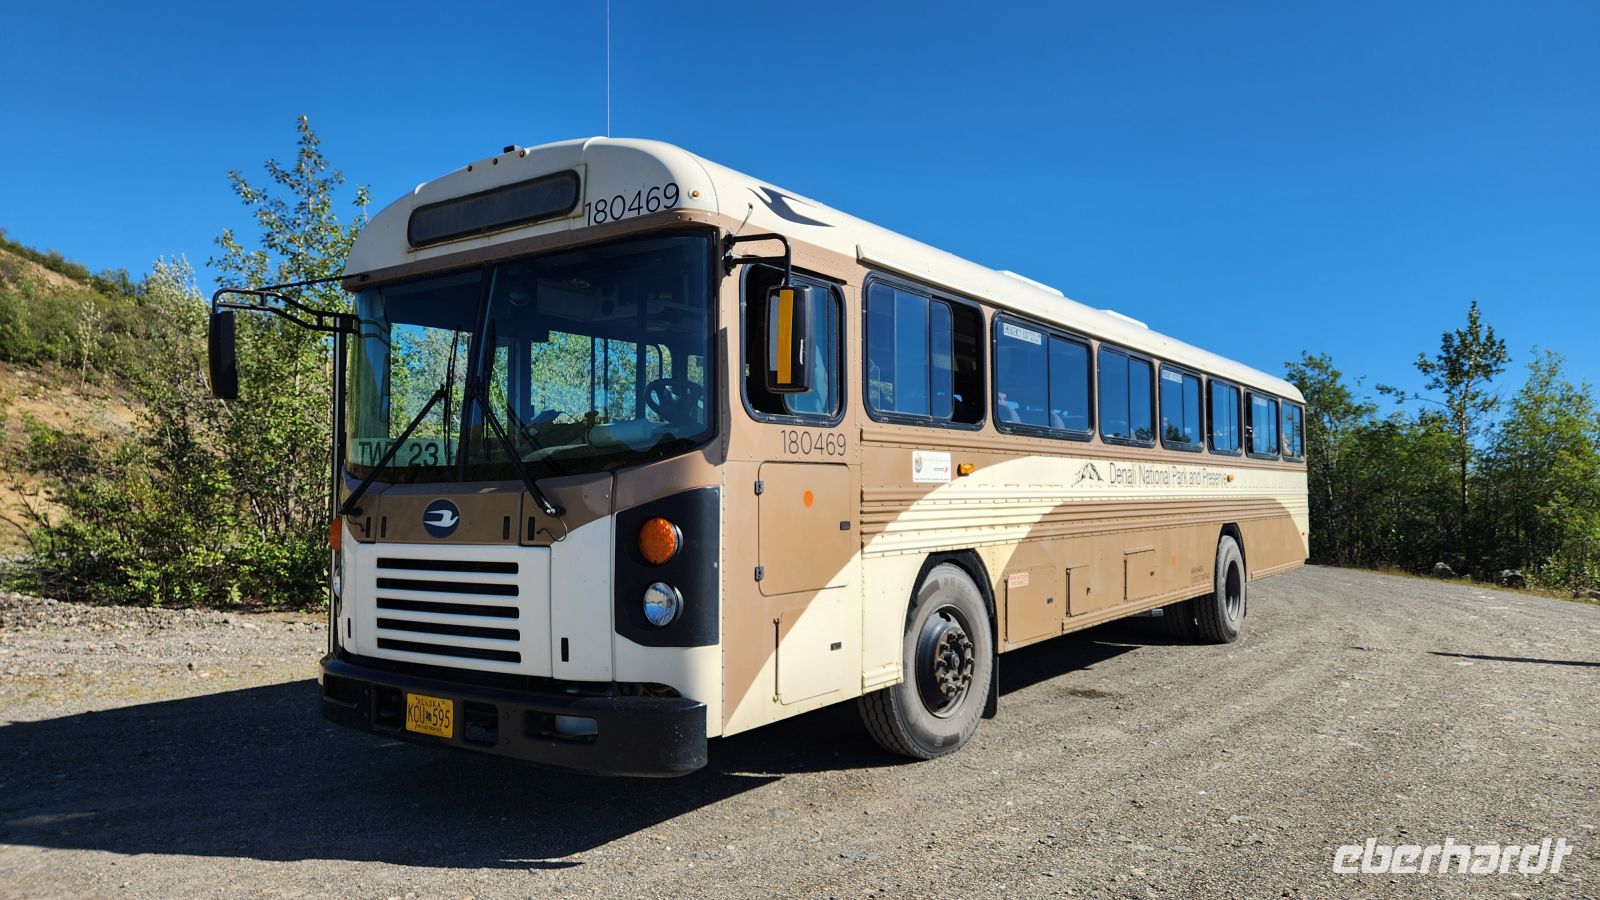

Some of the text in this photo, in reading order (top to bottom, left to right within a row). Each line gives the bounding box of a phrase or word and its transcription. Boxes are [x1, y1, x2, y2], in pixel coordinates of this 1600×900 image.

[585, 182, 680, 226] 180469
[407, 442, 439, 468] 23
[781, 429, 846, 456] 180469
[1109, 462, 1137, 485] Denali
[1139, 464, 1171, 485] National
[1172, 466, 1188, 486] Park
[1189, 468, 1202, 486] and
[407, 703, 425, 724] KCU
[432, 707, 451, 729] 595
